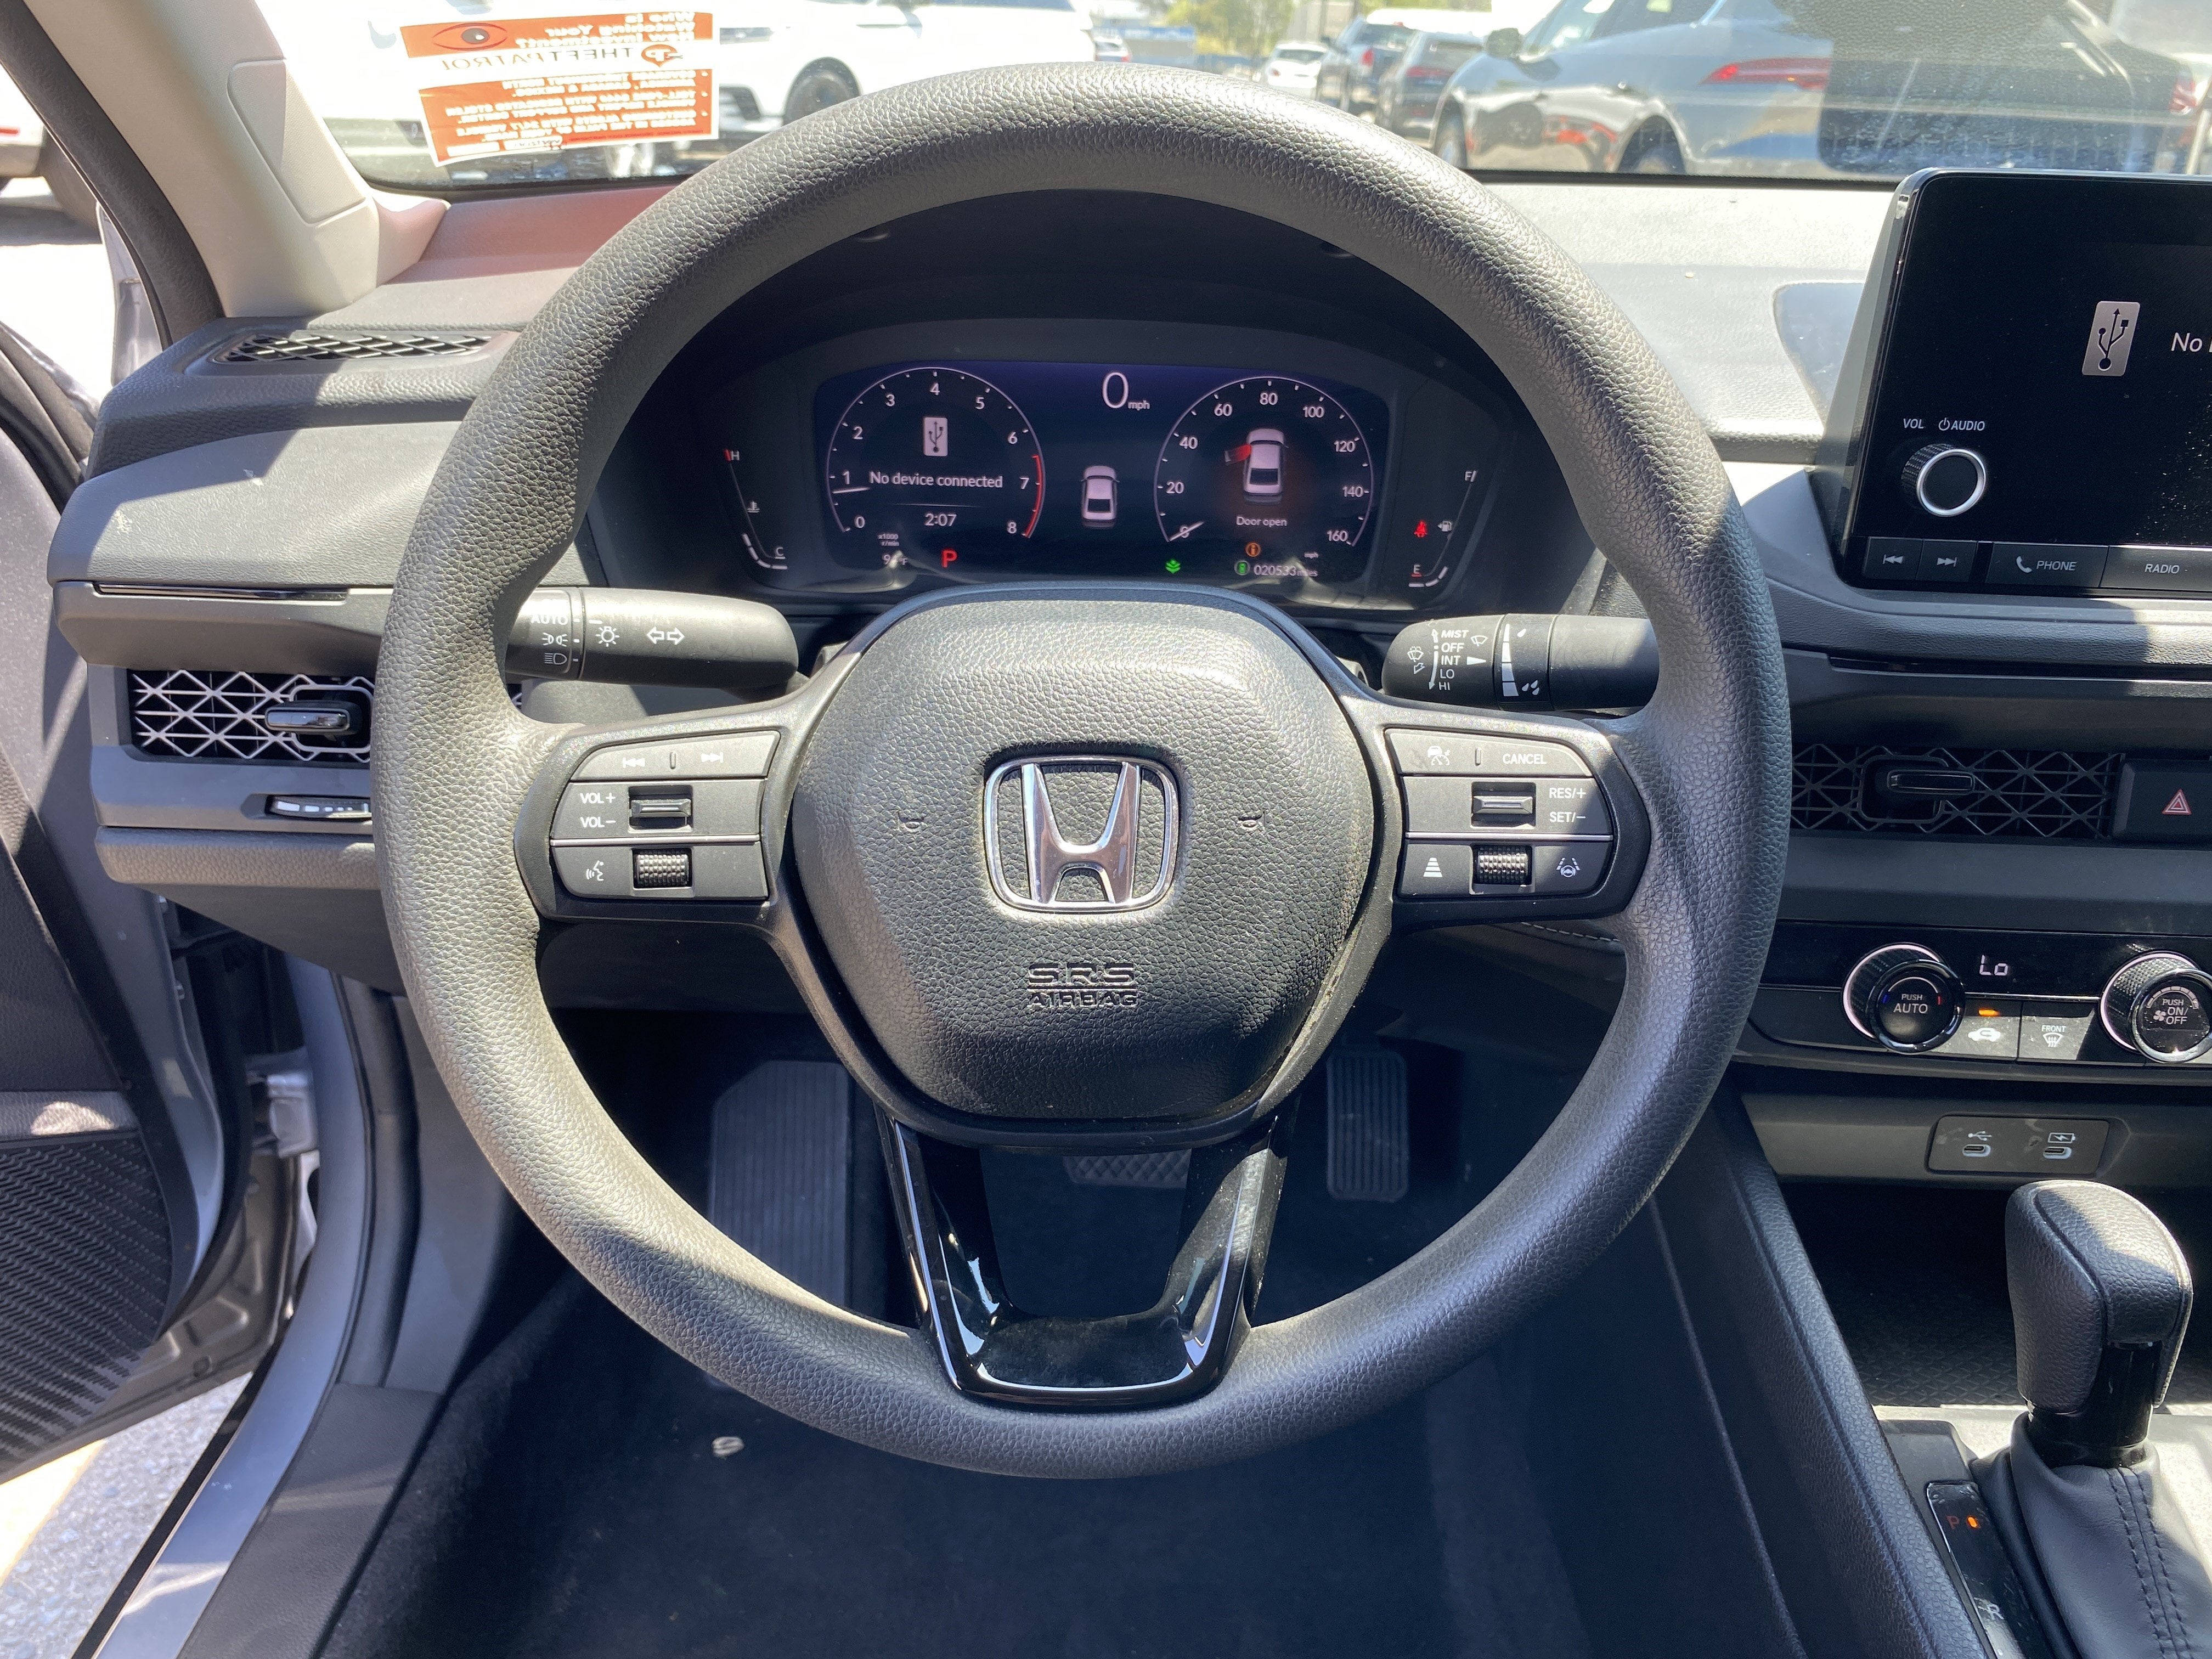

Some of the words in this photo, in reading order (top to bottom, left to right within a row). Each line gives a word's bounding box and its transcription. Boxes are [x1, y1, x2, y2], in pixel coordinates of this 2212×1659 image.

[2171, 332, 2203, 352] No
[930, 382, 940, 396] 4
[1102, 372, 1129, 409] 0
[1128, 399, 1150, 411] mph
[885, 393, 896, 407] 3
[975, 397, 985, 410] 5
[1259, 392, 1279, 407] 80
[1214, 403, 1233, 417] 60
[1302, 405, 1325, 419] 100
[1903, 419, 1925, 430] VOL
[1951, 420, 1985, 432] AUDIO
[853, 426, 864, 440] 2
[1007, 432, 1018, 445] 6
[1179, 436, 1198, 450] 40
[1333, 439, 1356, 453] 120
[731, 450, 740, 461] H
[842, 471, 851, 484] 1
[868, 471, 889, 485] No
[892, 472, 933, 487] device
[936, 475, 1003, 488] connected
[1019, 477, 1029, 489] 7
[1166, 481, 1184, 494] 20
[1342, 485, 1364, 499] 140
[854, 515, 865, 529] 0
[924, 513, 957, 527] 2:07
[1236, 516, 1260, 527] Door
[1262, 517, 1288, 529] open
[1006, 521, 1017, 534] 8
[1327, 529, 1348, 543] 160
[941, 549, 958, 568] P
[1412, 563, 1421, 575] E
[2036, 560, 2077, 572] PHONE
[2144, 563, 2180, 575] RADIO
[531, 614, 568, 626] AUTO
[1441, 629, 1470, 639] MIST
[1441, 643, 1464, 653] OFF
[1441, 655, 1459, 665] INT
[1440, 669, 1455, 679] LO
[1438, 681, 1451, 691] HI
[1502, 753, 1547, 765] CANCEL
[1549, 787, 1587, 799] RES/+
[1028, 962, 1136, 986] SRS
[1027, 991, 1139, 1008] AIRBAG
[1901, 993, 1923, 1002] PUSH
[2162, 998, 2185, 1007] PUSH
[1893, 1003, 1928, 1014] AUTO
[2167, 1006, 2188, 1017] ON/
[2166, 1015, 2188, 1026] OFF
[2041, 1025, 2067, 1034] FRONT
[1947, 1515, 1959, 1529] P
